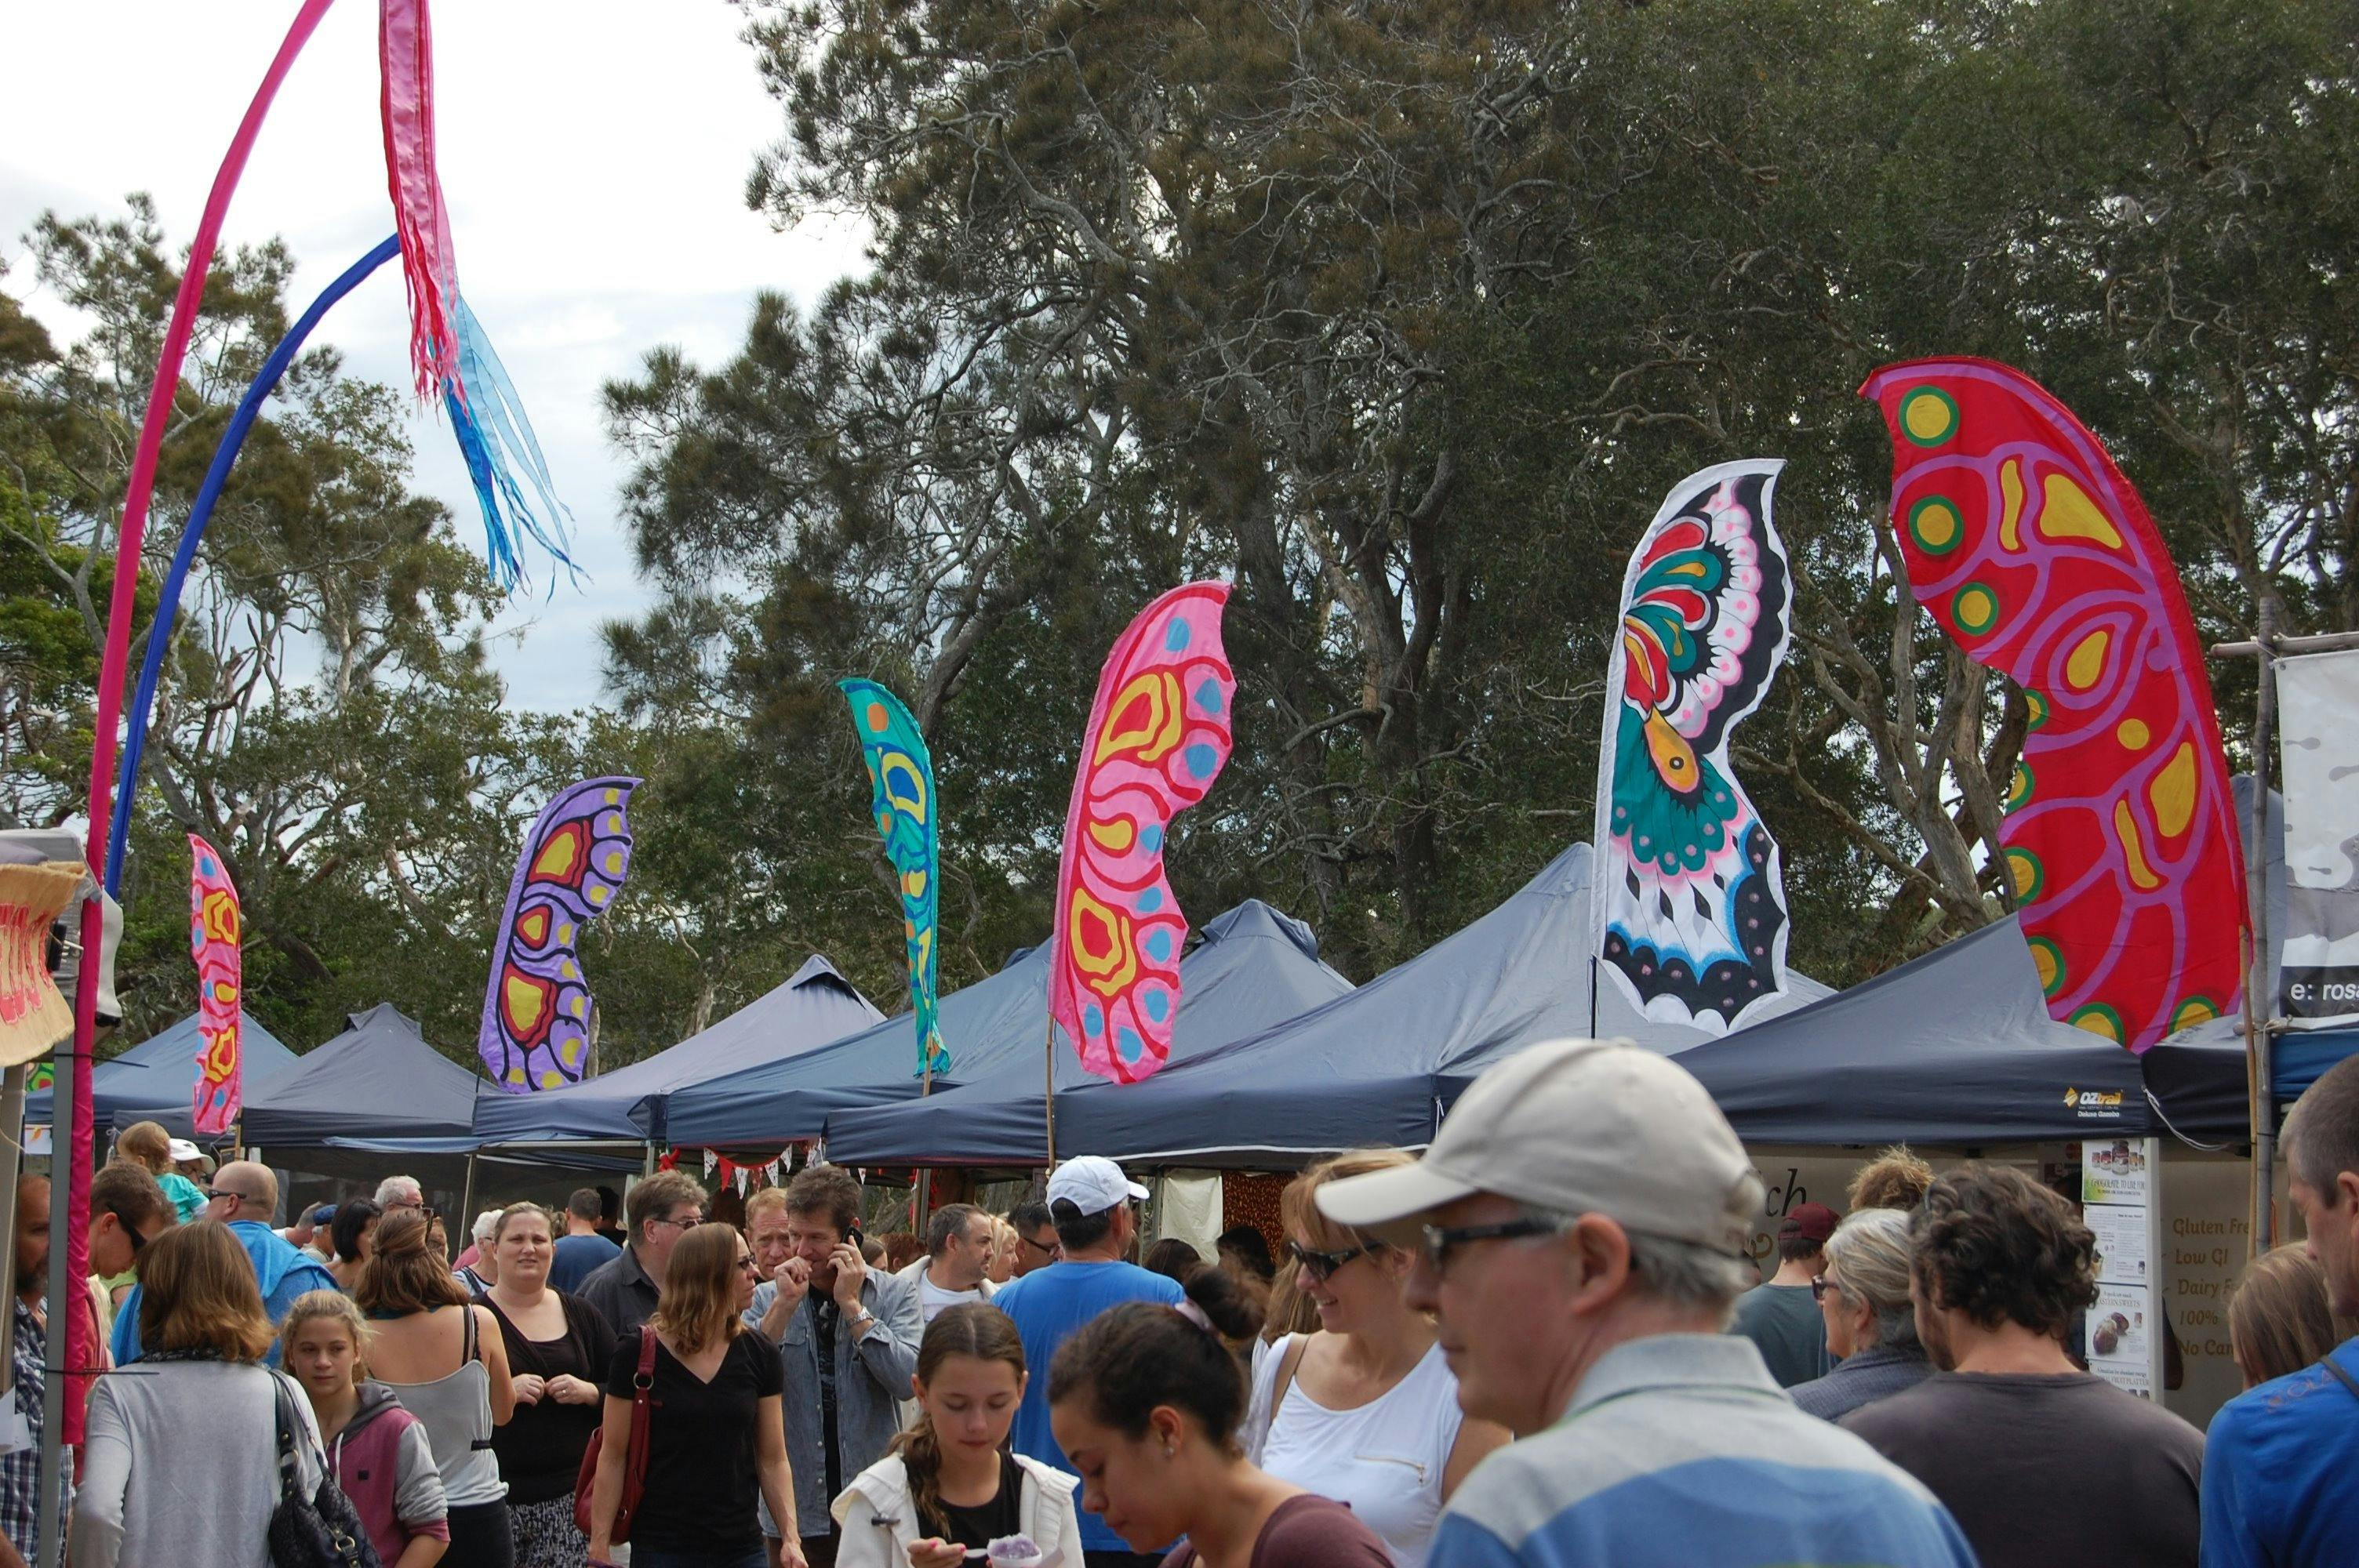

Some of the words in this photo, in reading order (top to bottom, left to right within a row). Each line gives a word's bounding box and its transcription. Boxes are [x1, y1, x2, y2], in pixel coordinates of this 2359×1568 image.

[2291, 983, 2313, 1000] e:
[2323, 983, 2359, 1000] ros
[2080, 1091, 2121, 1105] OZtrail
[1765, 1168, 1807, 1217] ch
[2172, 1218, 2224, 1236] Gluten
[2229, 1218, 2248, 1234] Fre
[2175, 1249, 2206, 1265] Low
[2178, 1279, 2219, 1298] Dairy
[2179, 1310, 2219, 1325] 100%
[2205, 1339, 2234, 1356] Can
